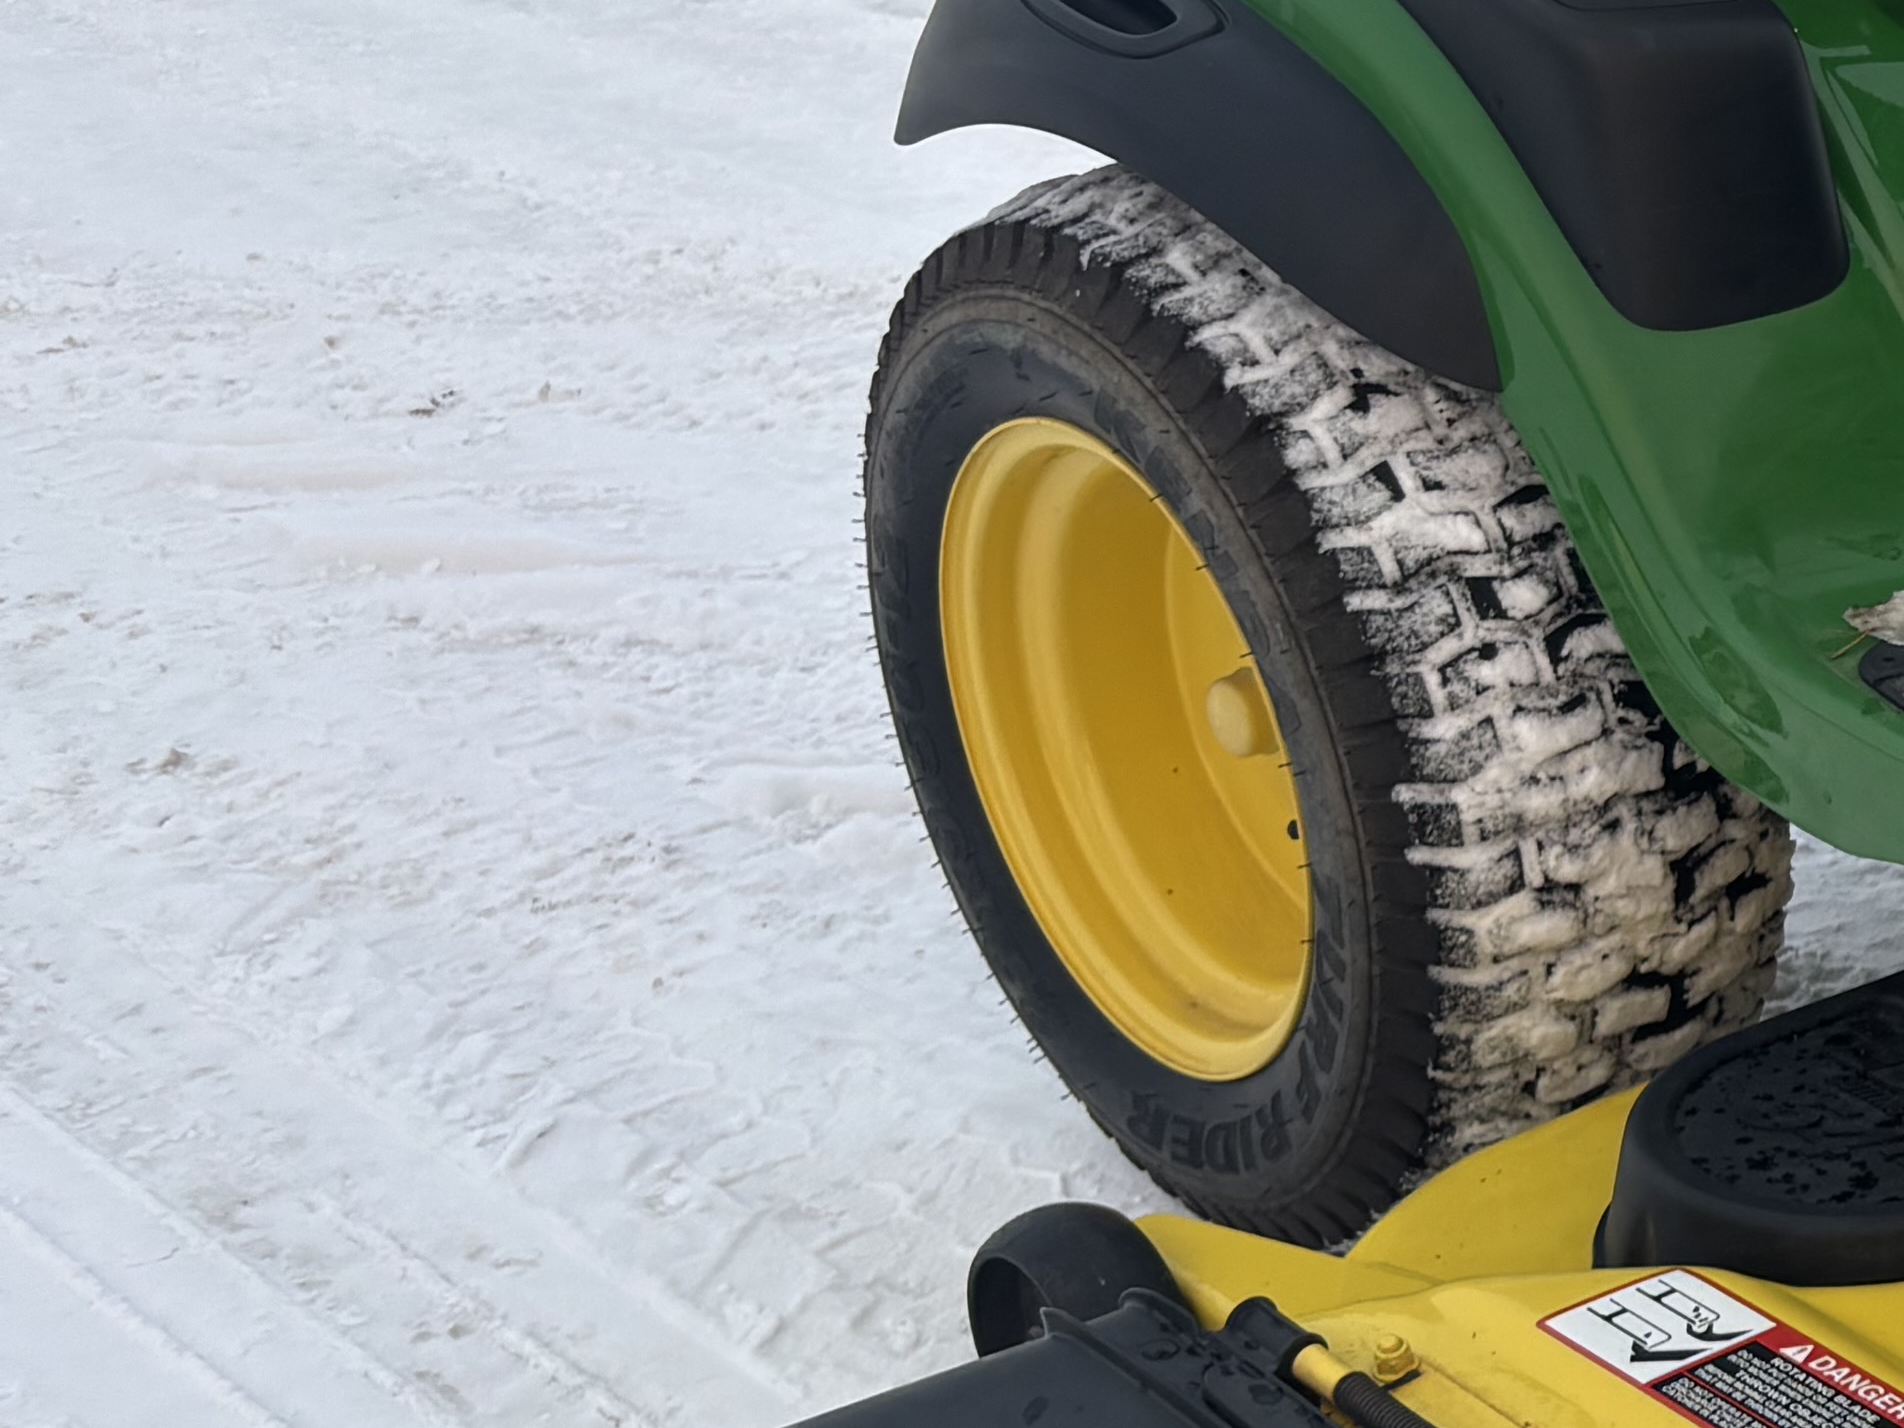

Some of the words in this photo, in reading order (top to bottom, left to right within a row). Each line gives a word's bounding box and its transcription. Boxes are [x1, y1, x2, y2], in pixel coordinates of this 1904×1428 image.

[1282, 865, 1348, 1129] TURF
[1124, 1082, 1305, 1178] RIDER
[1733, 1371, 1791, 1404] THROWN
[1768, 1357, 1837, 1396] ROTATING
[1832, 1395, 1881, 1422] BLADE
